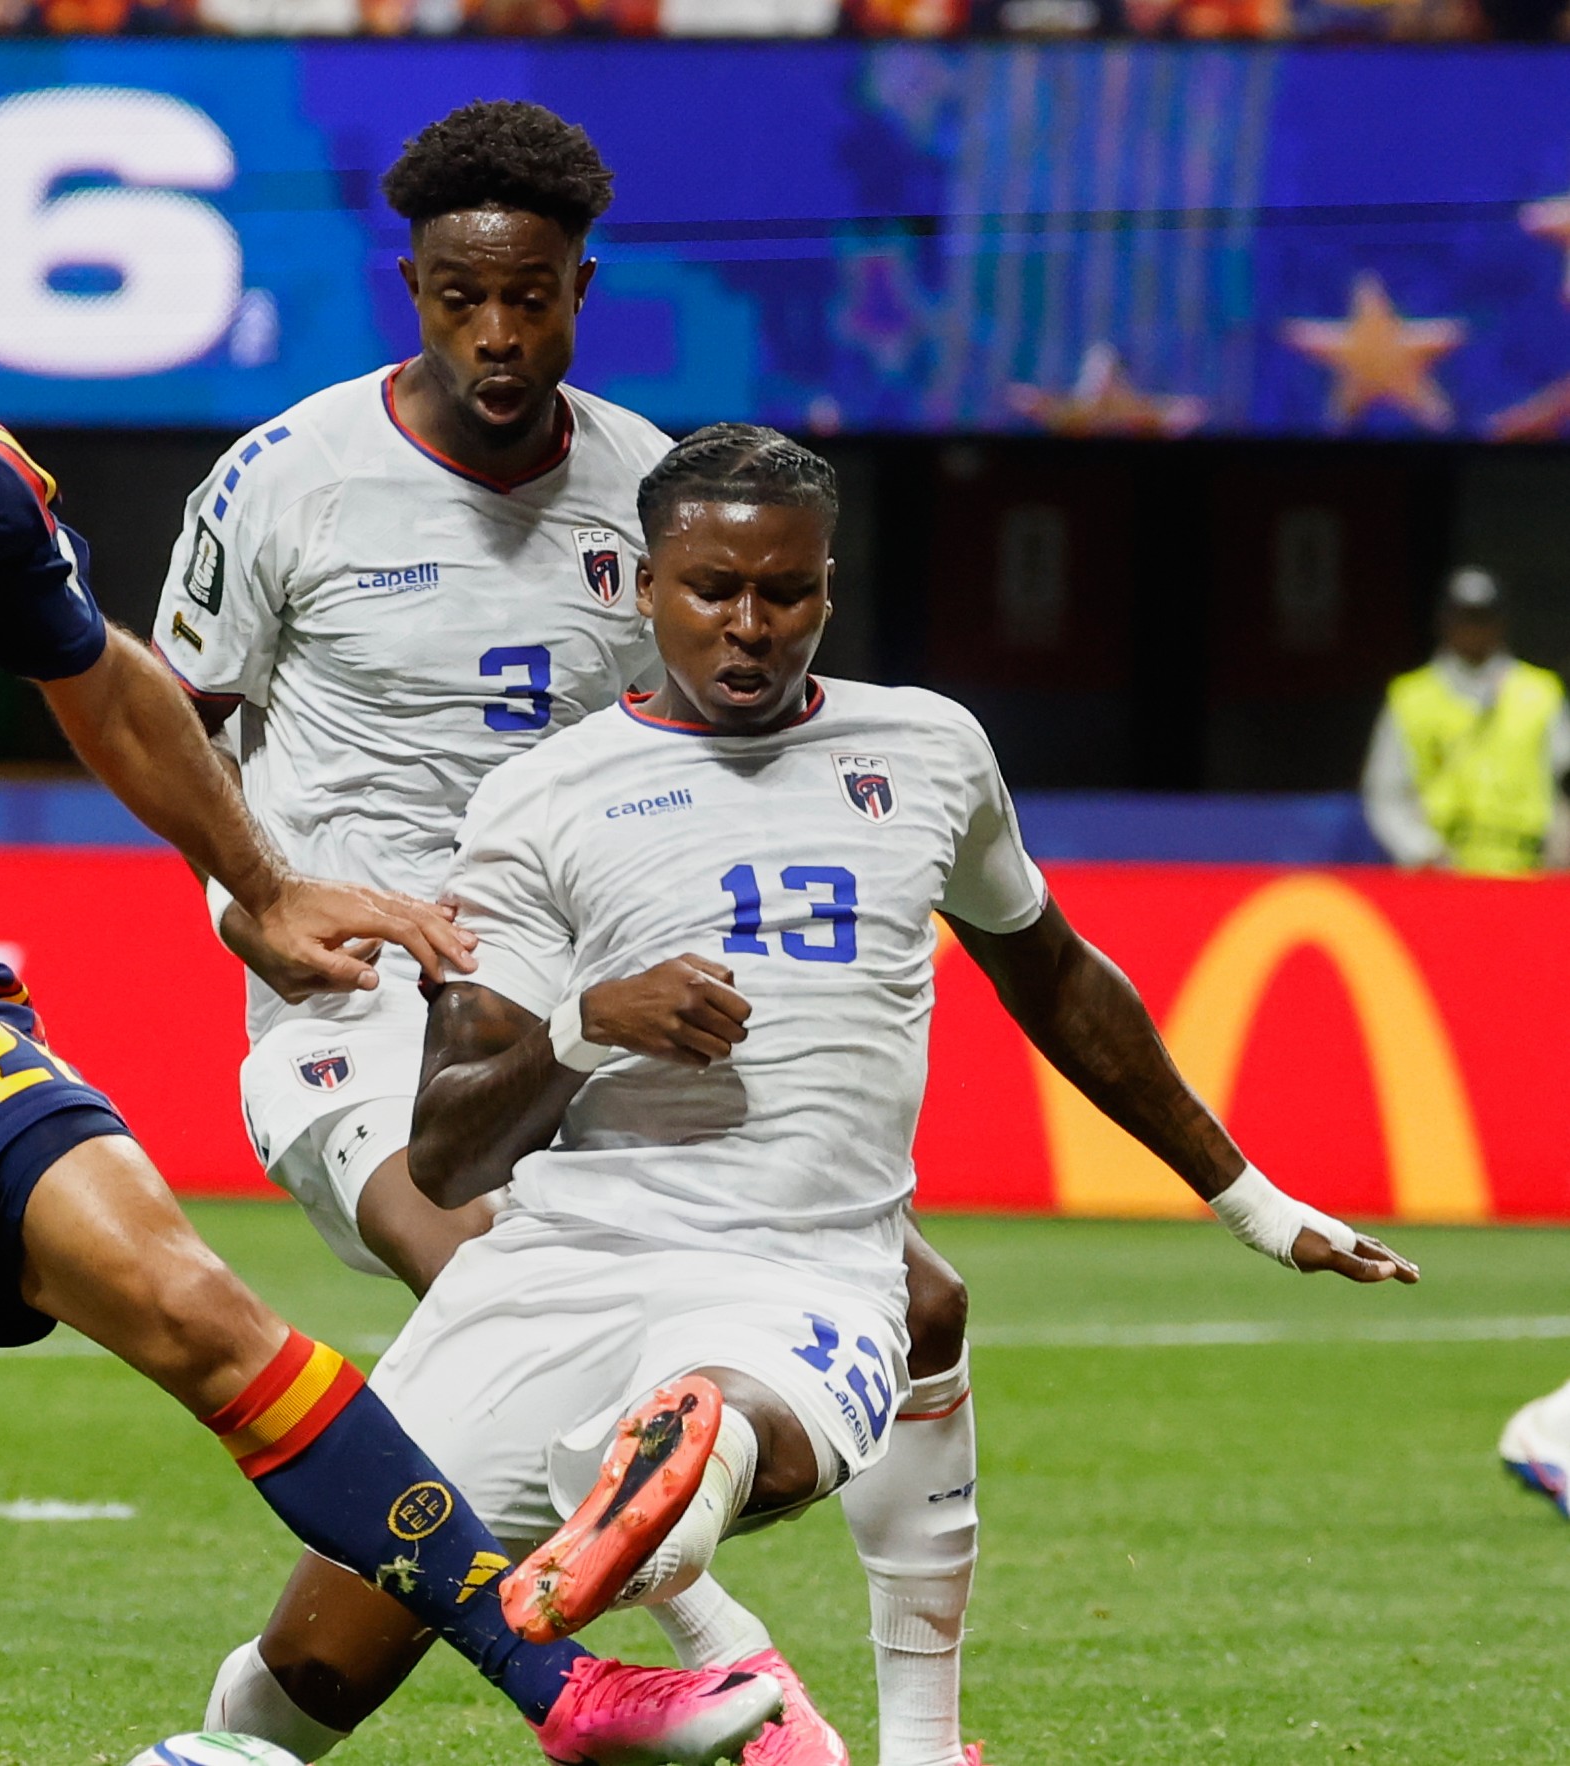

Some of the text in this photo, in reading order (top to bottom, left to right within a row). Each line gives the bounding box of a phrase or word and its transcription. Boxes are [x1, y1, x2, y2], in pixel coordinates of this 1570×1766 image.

[578, 531, 614, 544] FCF
[479, 645, 552, 732] 3
[838, 756, 883, 768] FCF
[606, 788, 693, 820] capelli
[721, 864, 858, 964] 13
[791, 1312, 892, 1444] 13
